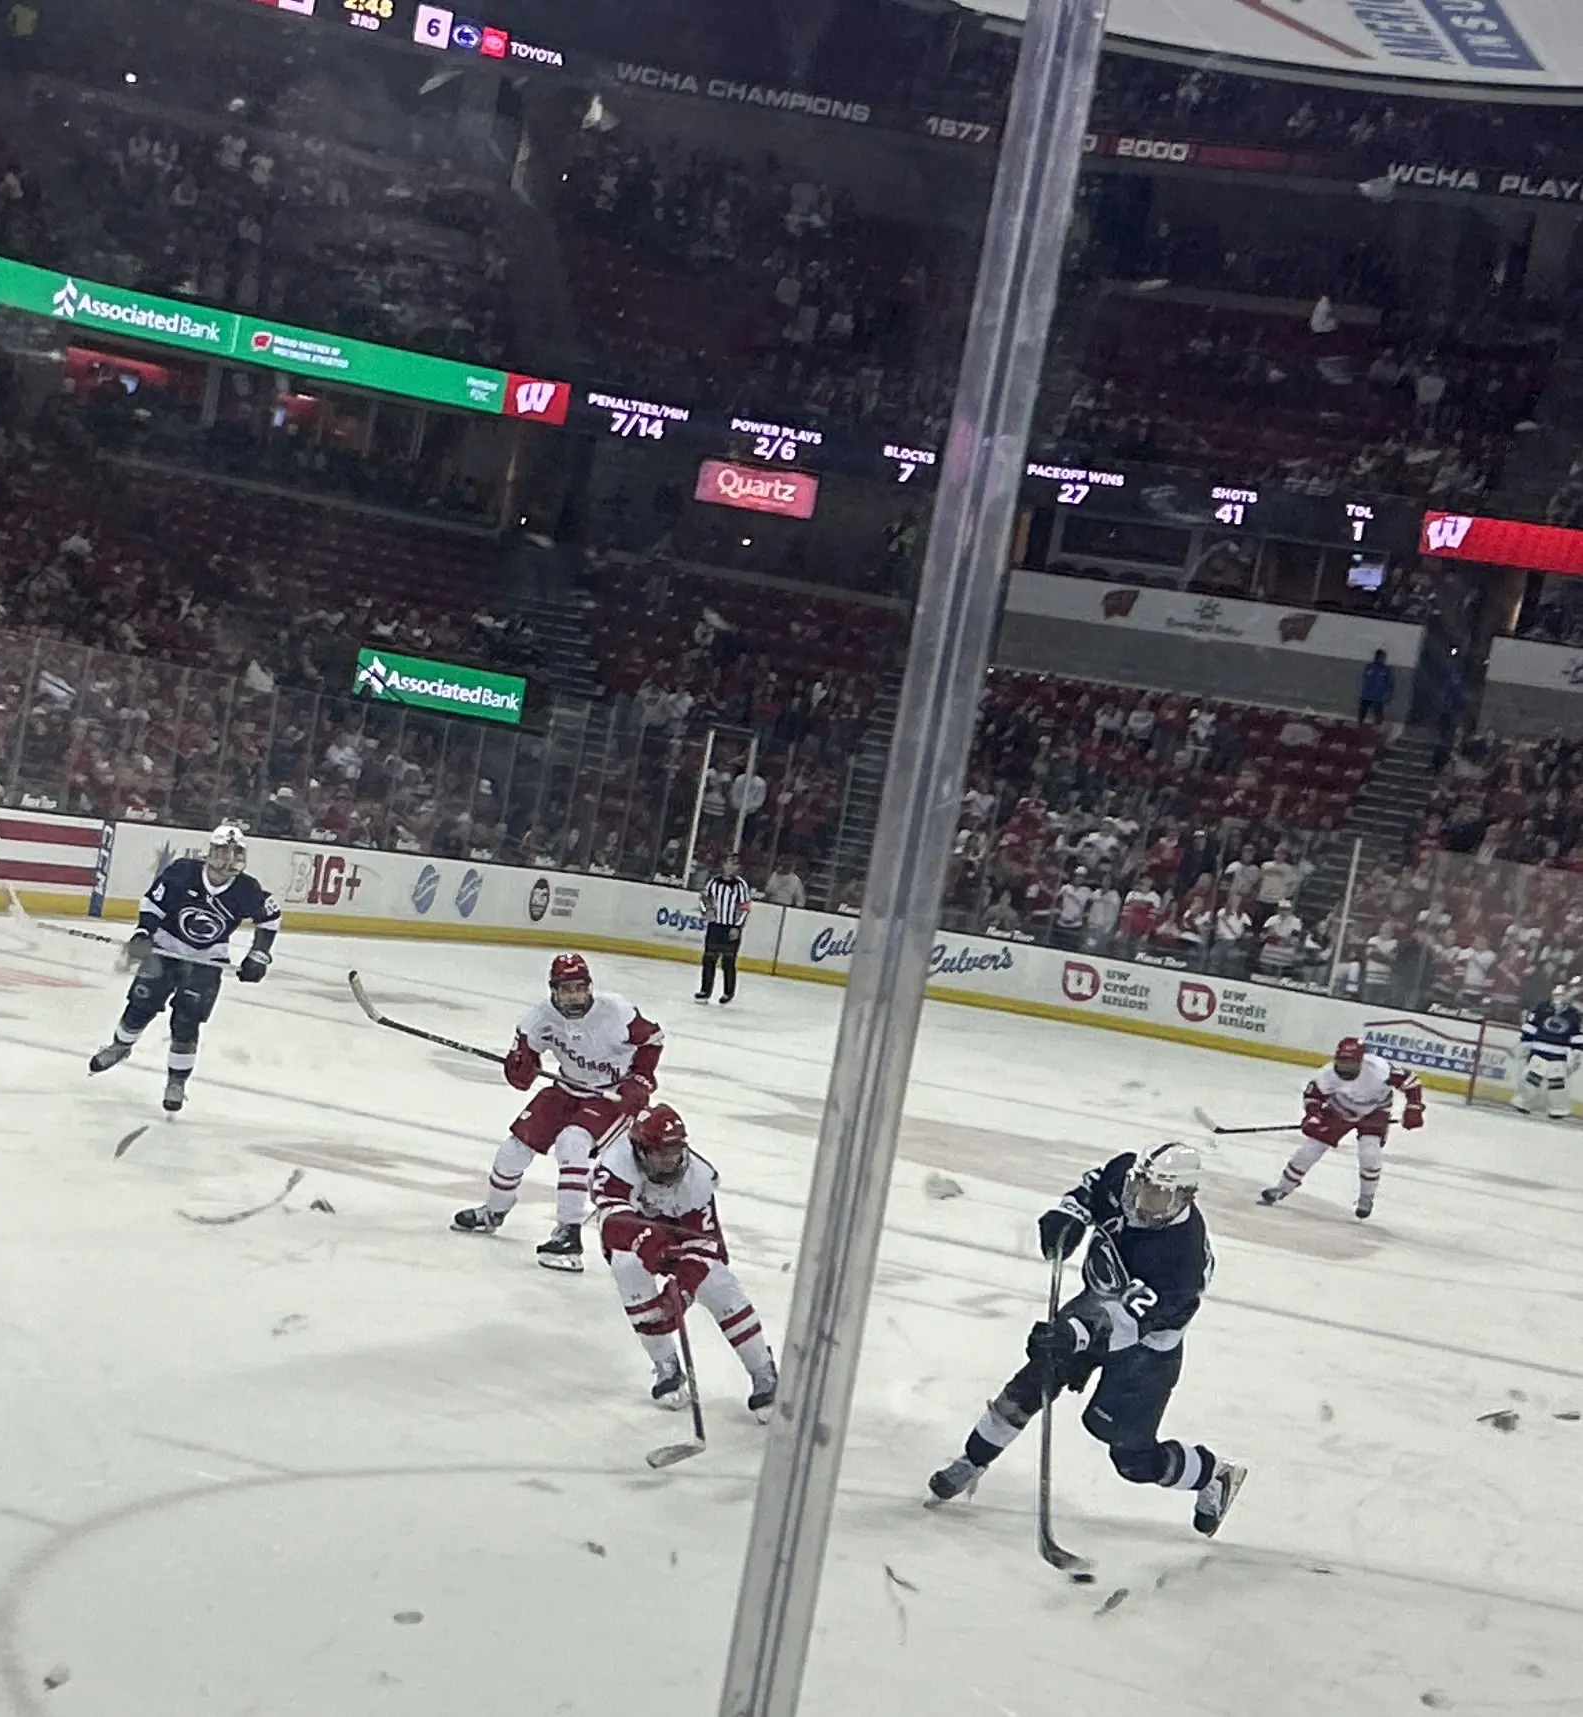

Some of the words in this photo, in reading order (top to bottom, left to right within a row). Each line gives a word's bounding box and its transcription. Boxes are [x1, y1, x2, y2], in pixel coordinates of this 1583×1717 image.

[349, 12, 380, 31] 3RD
[426, 18, 441, 37] 6
[510, 41, 563, 67] TOYOTA
[617, 62, 699, 94] WCHA
[707, 79, 871, 123] CHAMPIONS
[1117, 137, 1190, 162] 2000
[1387, 161, 1478, 190] WCHA
[1499, 174, 1583, 201] PLAY
[588, 393, 689, 422] PENALTIES/MIN
[610, 413, 664, 440] 7/14
[731, 418, 780, 437] POWER
[781, 427, 822, 445] PLAYS
[753, 437, 796, 461] 2/6
[884, 445, 935, 465] BLOCKS
[898, 463, 915, 482] 7
[1027, 464, 1087, 482] FACEOFF
[1088, 471, 1124, 487] WINS
[718, 468, 796, 504] Quartz
[1057, 484, 1089, 505] 27
[1212, 487, 1257, 504] SHOTS
[1215, 503, 1244, 526] 41
[1346, 503, 1374, 519] TOL
[1352, 521, 1365, 542] 1
[655, 905, 708, 932] Odyss
[928, 944, 1014, 976] Culver's
[1106, 968, 1131, 983] uw
[1103, 980, 1151, 998] credit
[1222, 988, 1247, 1003] uw
[1101, 993, 1149, 1012] union
[1219, 1002, 1267, 1019] credit
[1217, 1013, 1266, 1034] union
[1365, 1030, 1446, 1055] AMERICAN
